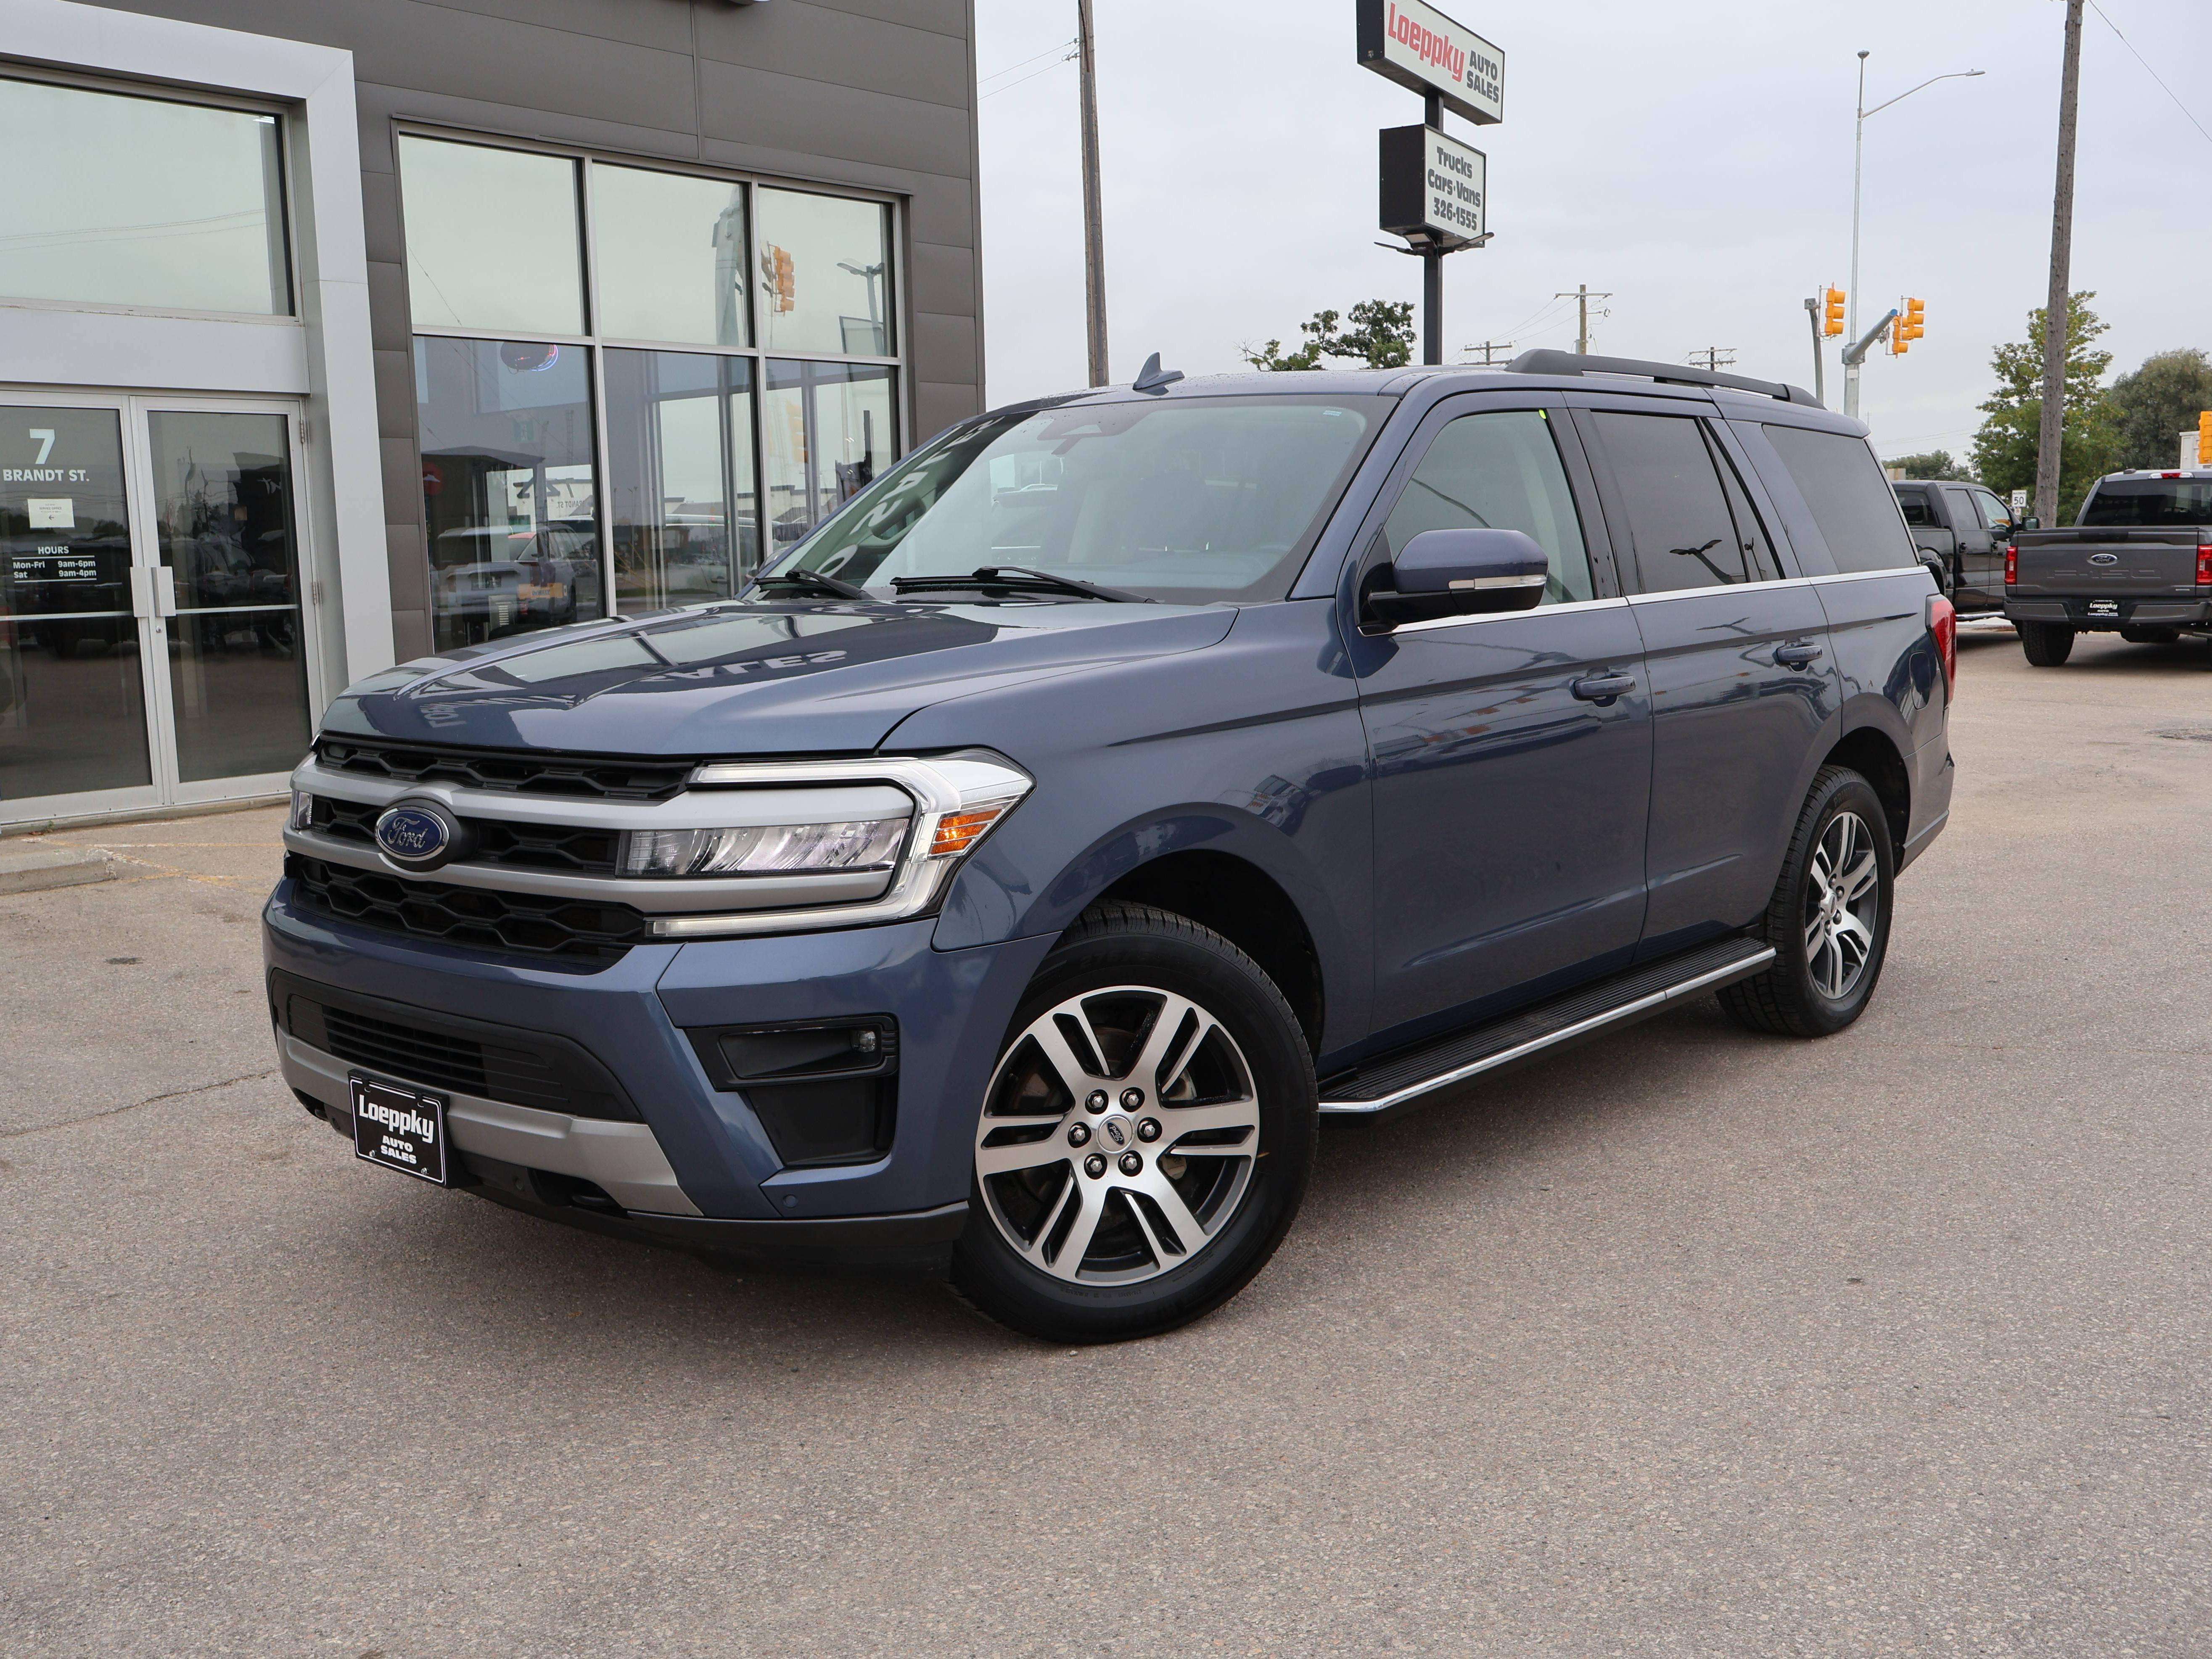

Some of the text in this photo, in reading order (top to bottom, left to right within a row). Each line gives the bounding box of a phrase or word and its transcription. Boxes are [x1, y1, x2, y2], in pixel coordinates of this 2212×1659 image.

[1388, 3, 1465, 82] Loeppky
[1469, 50, 1498, 81] AUTO
[1466, 71, 1499, 103] SALES
[1437, 145, 1472, 179] Trucks
[1434, 197, 1477, 231] 326-1555
[29, 428, 55, 464] 7
[3, 469, 90, 482] BRANDT ST.
[58, 560, 96, 568] 9am-6pm
[59, 569, 97, 578] 9am-4pm
[387, 817, 428, 848] Ford
[359, 1094, 433, 1144] Loeppky
[1110, 1125, 1123, 1141] Ford
[381, 1145, 417, 1164] SALES
[383, 1135, 413, 1152] AUTO
